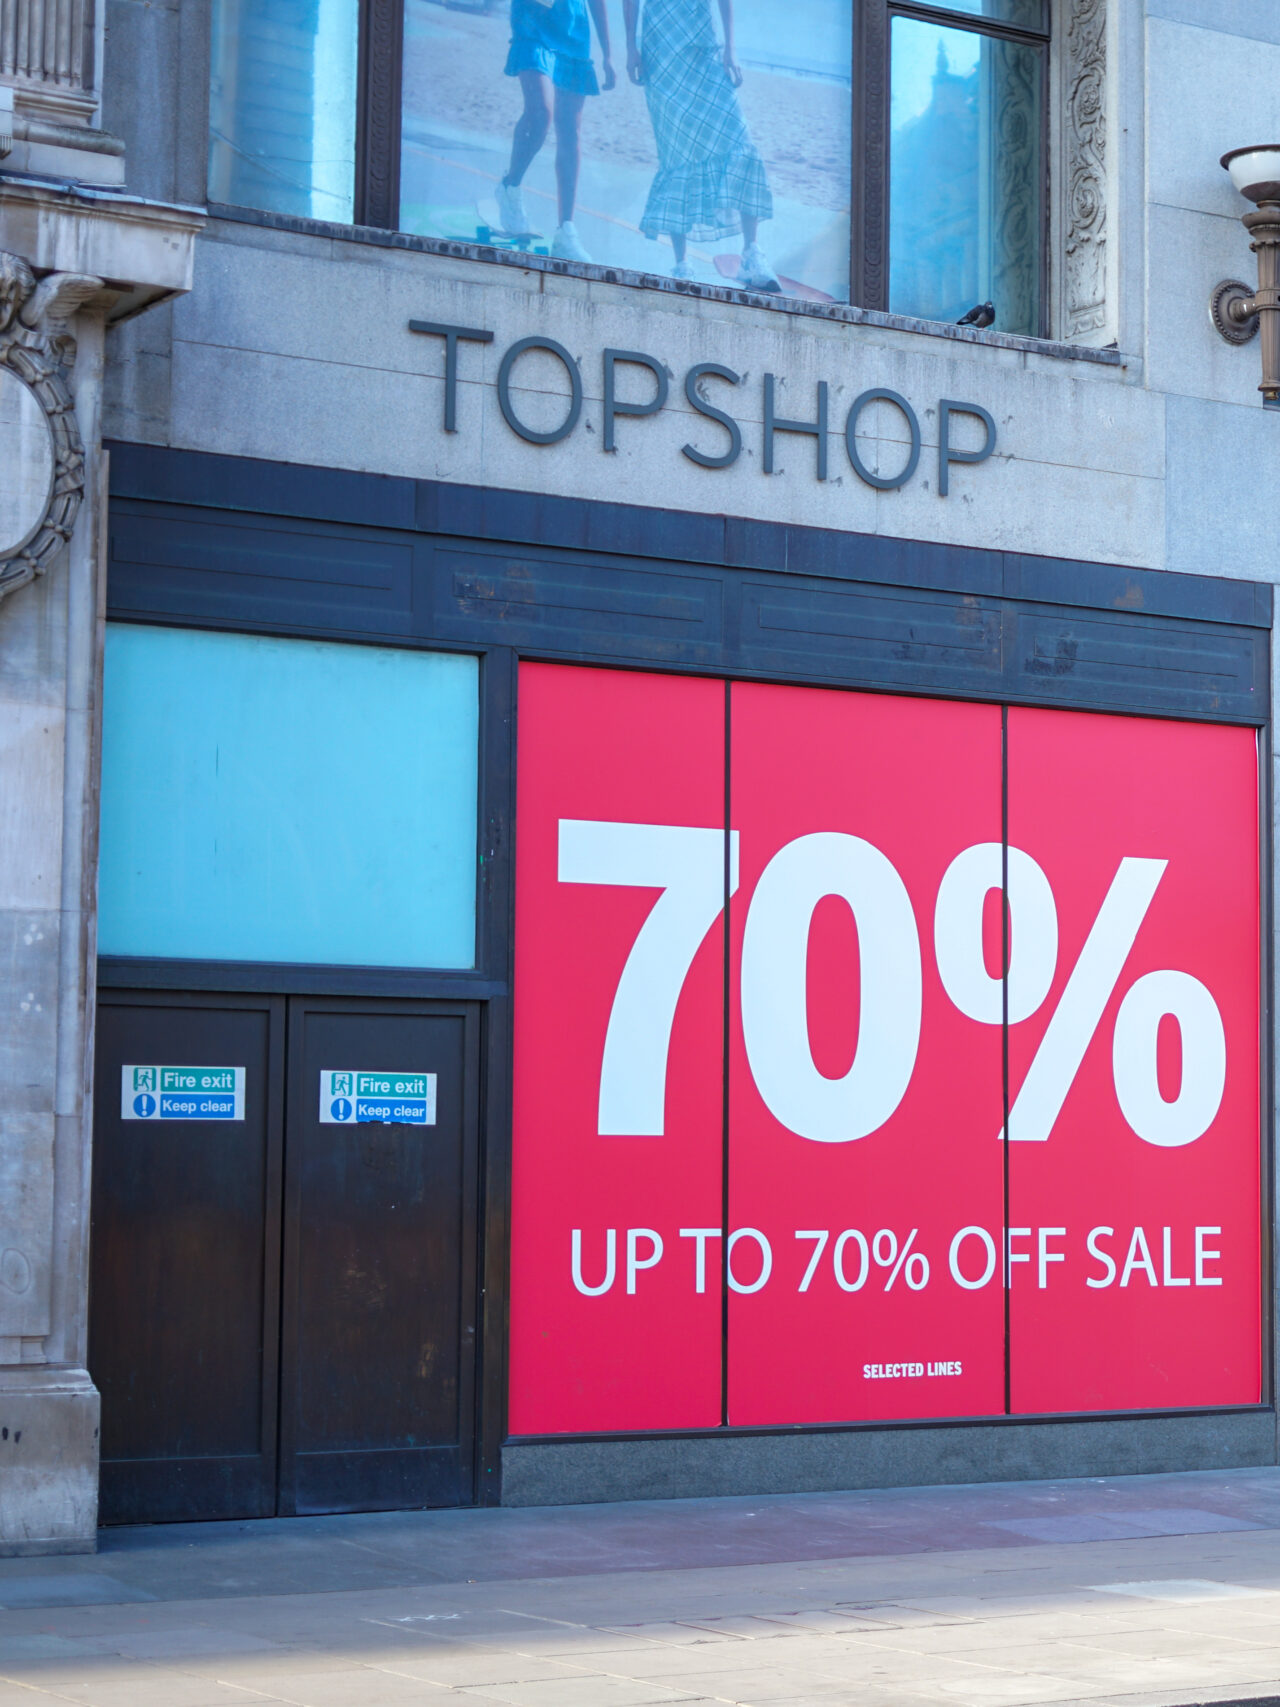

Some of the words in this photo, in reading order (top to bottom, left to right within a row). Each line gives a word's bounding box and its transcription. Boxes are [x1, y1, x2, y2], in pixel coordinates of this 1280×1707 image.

[408, 319, 997, 497] TOPSHOP
[557, 819, 1227, 1147] 70%
[164, 1072, 197, 1088] Fire
[201, 1072, 232, 1089] exit
[359, 1077, 390, 1093] Fire
[394, 1078, 424, 1094] exit
[162, 1099, 197, 1114] Keep
[200, 1099, 232, 1113] clear
[358, 1103, 391, 1119] Keep
[393, 1104, 425, 1117] clear
[570, 1229, 664, 1297] UP
[679, 1227, 773, 1295] TO
[795, 1229, 931, 1293] 70%
[948, 1226, 1067, 1290] OFF
[1086, 1226, 1223, 1288] SALE
[863, 1363, 924, 1379] SELECTED
[927, 1361, 962, 1377] LINES
